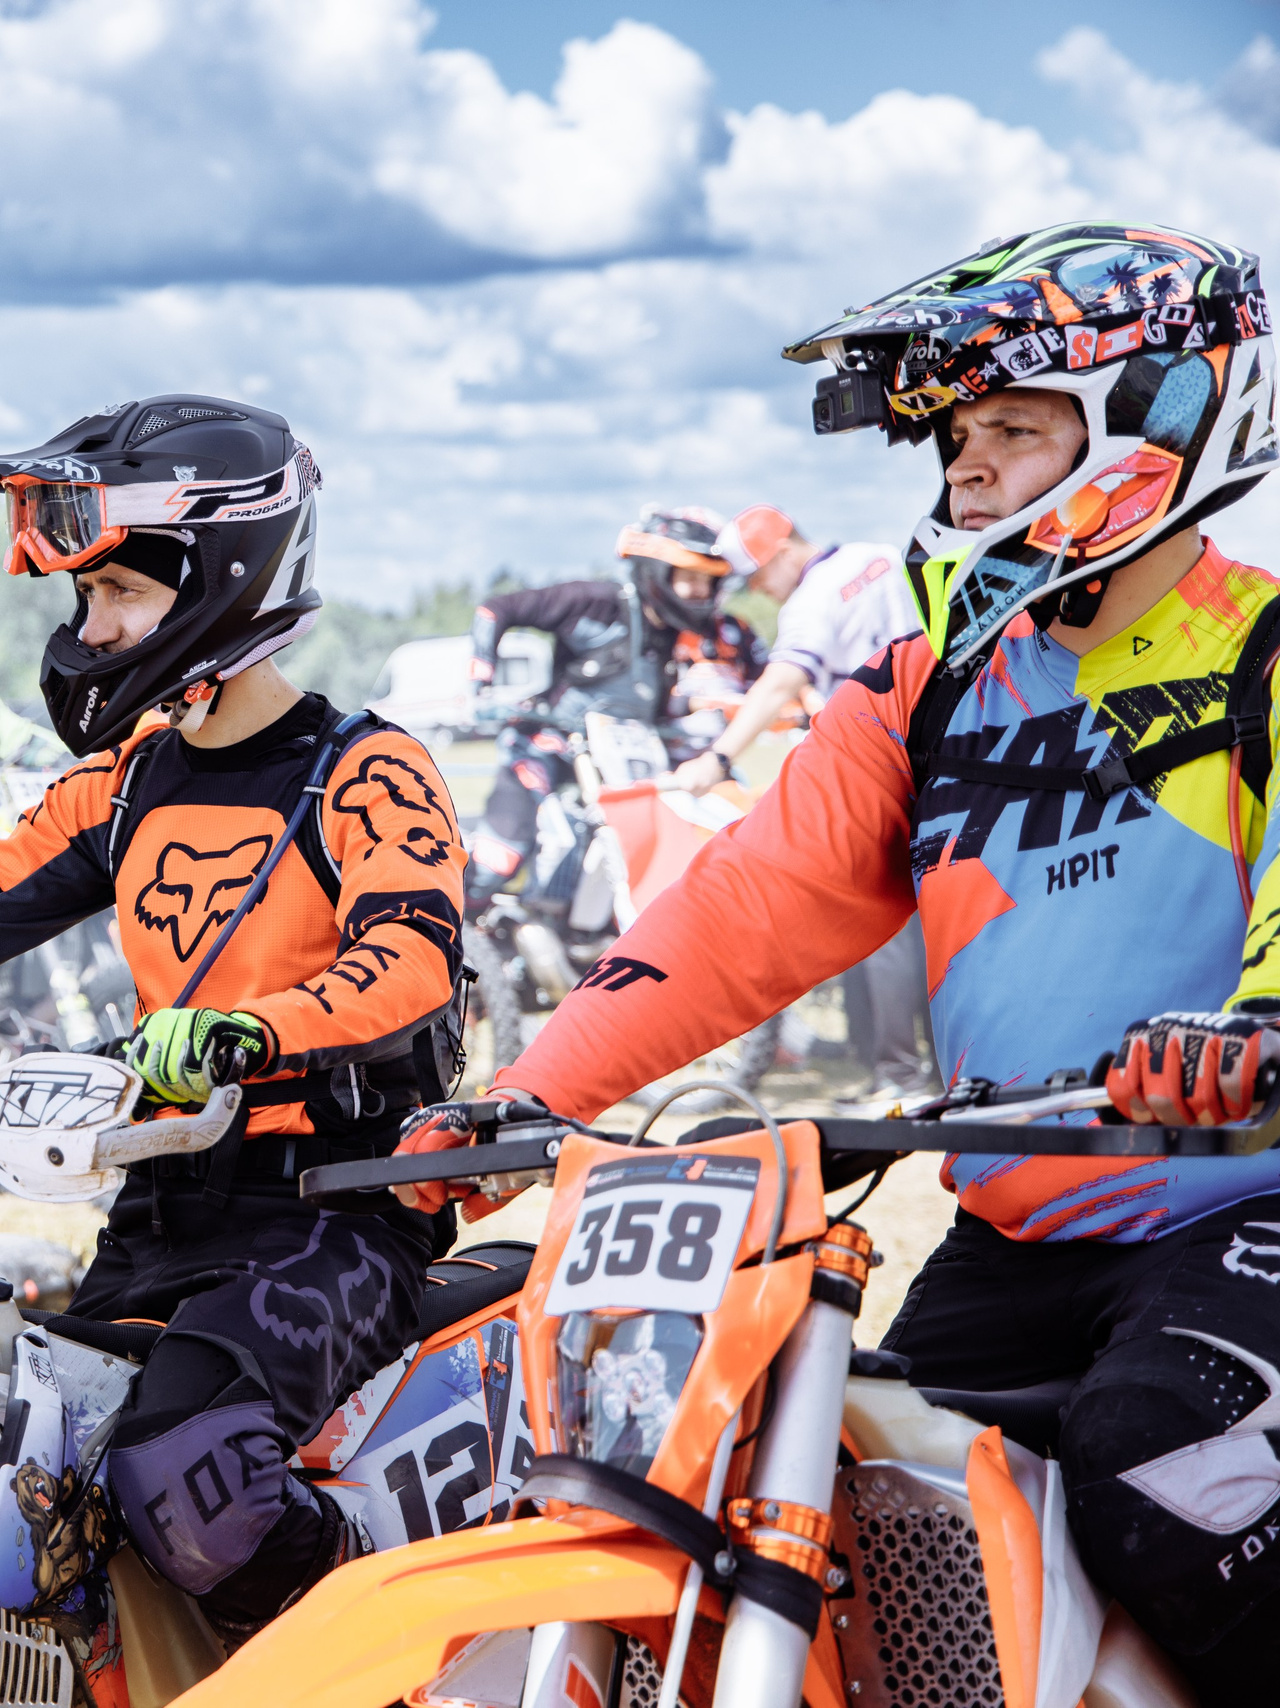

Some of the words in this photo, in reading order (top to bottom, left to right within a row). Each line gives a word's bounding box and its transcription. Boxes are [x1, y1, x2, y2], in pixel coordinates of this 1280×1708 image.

[977, 585, 1026, 632] AIROH
[78, 686, 100, 735] Airoh
[1046, 844, 1120, 896] HPIT
[294, 942, 401, 1015] FOX
[238, 1035, 262, 1053] UFO
[565, 1200, 722, 1286] 358
[144, 1436, 264, 1556] FOX
